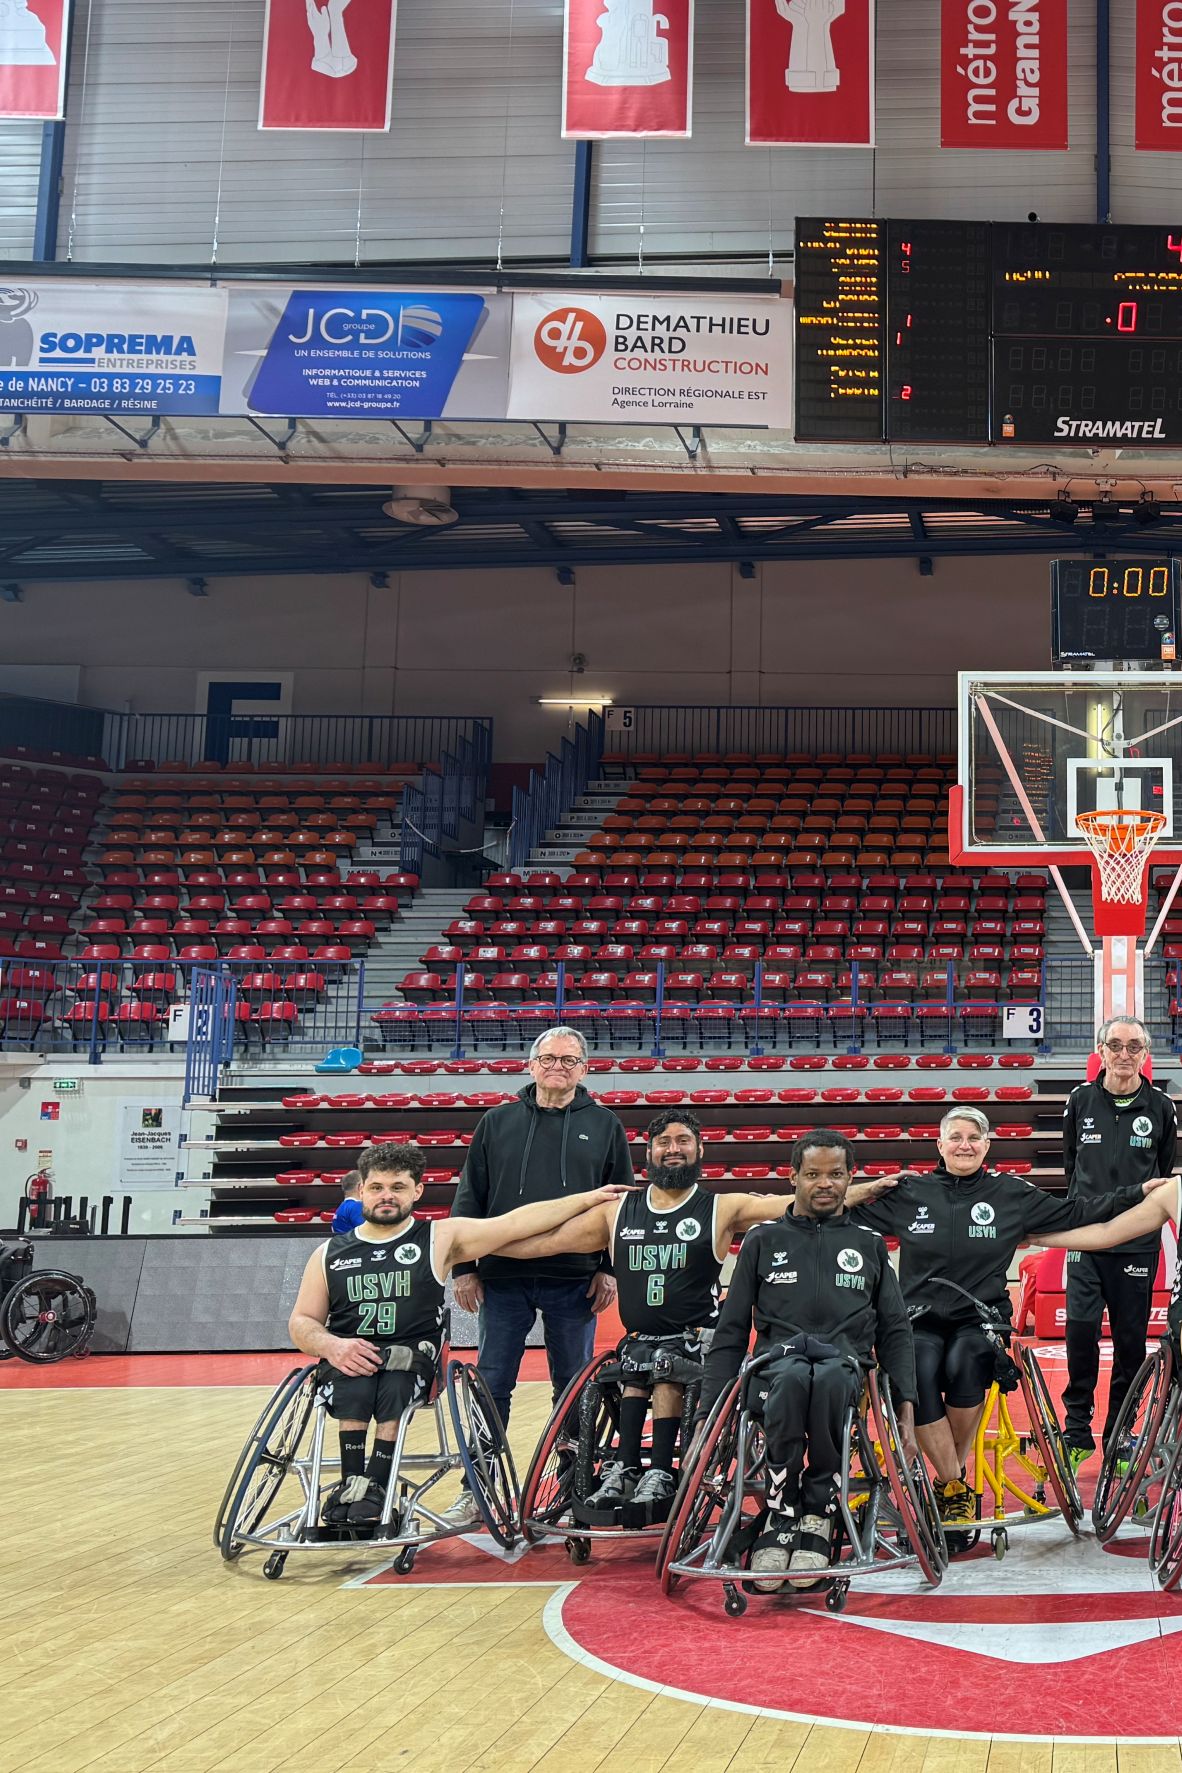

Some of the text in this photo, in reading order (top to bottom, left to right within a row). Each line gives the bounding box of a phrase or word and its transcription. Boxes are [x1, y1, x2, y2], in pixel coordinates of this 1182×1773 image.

[956, 0, 997, 125] métro
[288, 308, 394, 344] JCD
[616, 314, 770, 335] DEMATHIEU
[39, 332, 196, 356] SOPREMA
[614, 335, 686, 353] BARD
[97, 358, 196, 370] ENTREPRISES
[614, 358, 769, 375] CONSTRUCTION
[303, 369, 371, 377] INFORMATIQUE
[383, 370, 426, 378] SERVICES
[8, 377, 24, 391] de
[29, 378, 74, 392] NANCY
[91, 379, 108, 392] 03
[113, 379, 129, 393] 83
[135, 380, 150, 393] 29
[157, 380, 173, 393] 25
[178, 380, 195, 394] 23
[341, 379, 419, 387] COMMUNICATION
[612, 386, 767, 400] DIRECTION RÉGIONALE EST
[0, 396, 54, 407] TANCHÉITÉ
[64, 399, 110, 408] BARDAGE
[121, 399, 158, 408] RÉSINE
[612, 398, 694, 409] Agence Lorraine
[1089, 567, 1168, 597] 0:00
[207, 682, 281, 764] F
[608, 710, 632, 727] F 5
[173, 1010, 183, 1022] F
[1007, 1008, 1041, 1033] F 3
[968, 1226, 996, 1238] USVH
[629, 1243, 686, 1271] USVH
[347, 1270, 411, 1302] USVH
[647, 1274, 665, 1306] 6
[836, 1273, 865, 1290] USVH
[357, 1302, 396, 1335] 29
